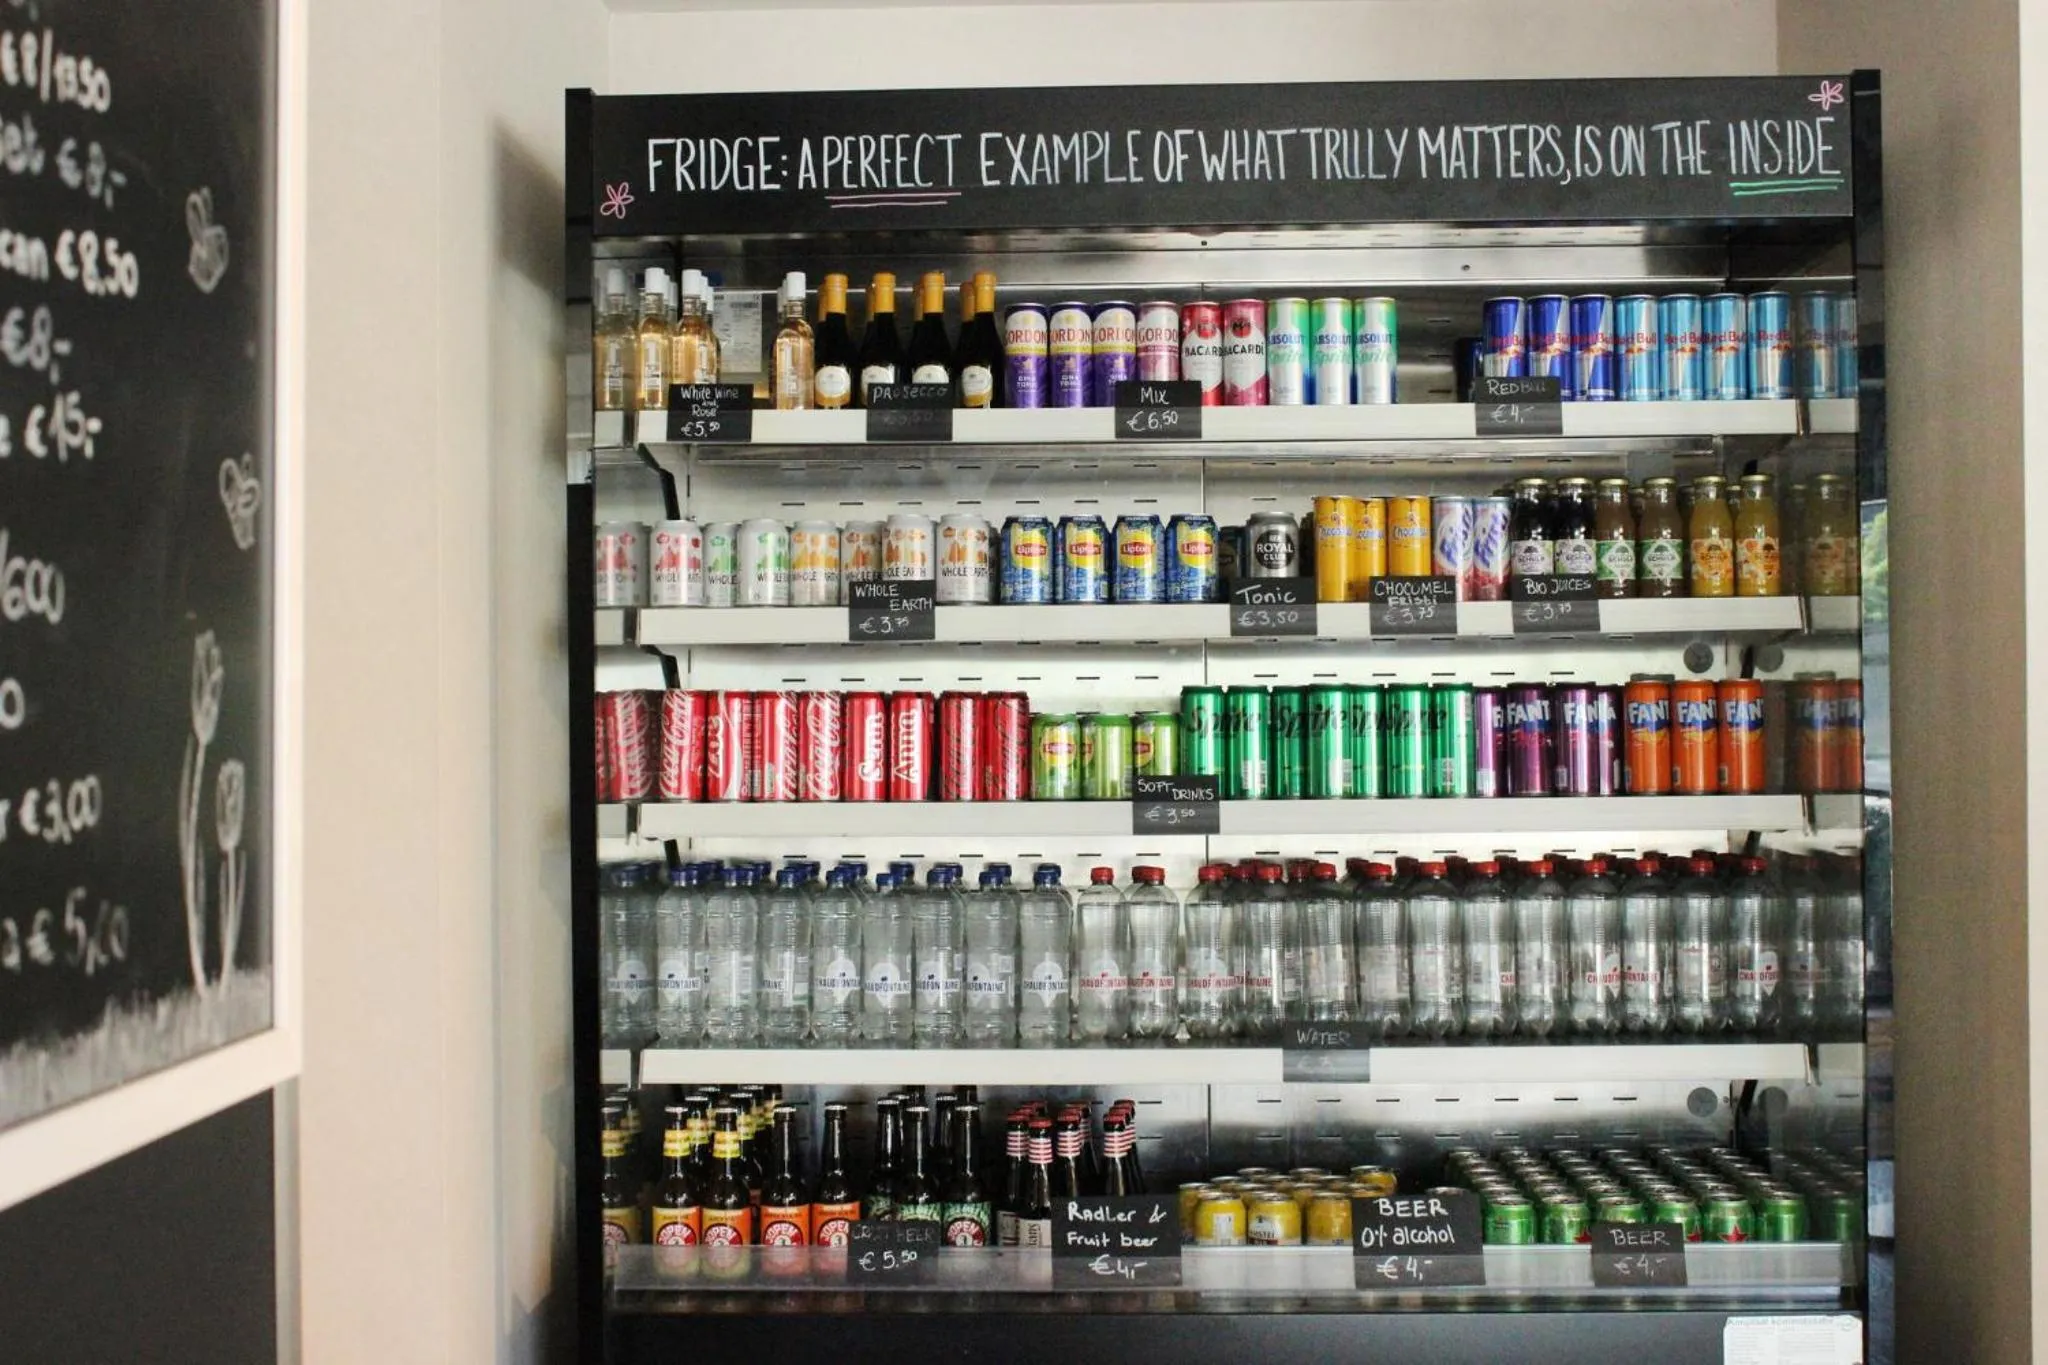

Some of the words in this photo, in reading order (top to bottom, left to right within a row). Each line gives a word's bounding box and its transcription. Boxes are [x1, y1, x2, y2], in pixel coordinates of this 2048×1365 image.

[647, 136, 788, 193] FRIDGE:
[798, 137, 817, 190] A
[822, 133, 963, 189] PERFECT
[979, 129, 1144, 187] EXAMPLE
[1153, 129, 1196, 183] OF
[1198, 127, 1298, 183] WHAT
[1610, 124, 1646, 177] ON
[1651, 120, 1712, 177] THE
[1729, 117, 1842, 175] INSIDE
[855, 583, 899, 598] WHOLE
[1236, 584, 1297, 604] Tonic
[889, 597, 933, 612] EARTH
[1373, 1198, 1449, 1217] BEER
[1067, 1232, 1110, 1247] Fruit
[1120, 1232, 1158, 1247] beer
[1392, 1224, 1455, 1246] alcohol
[1610, 1229, 1670, 1246] BEER
